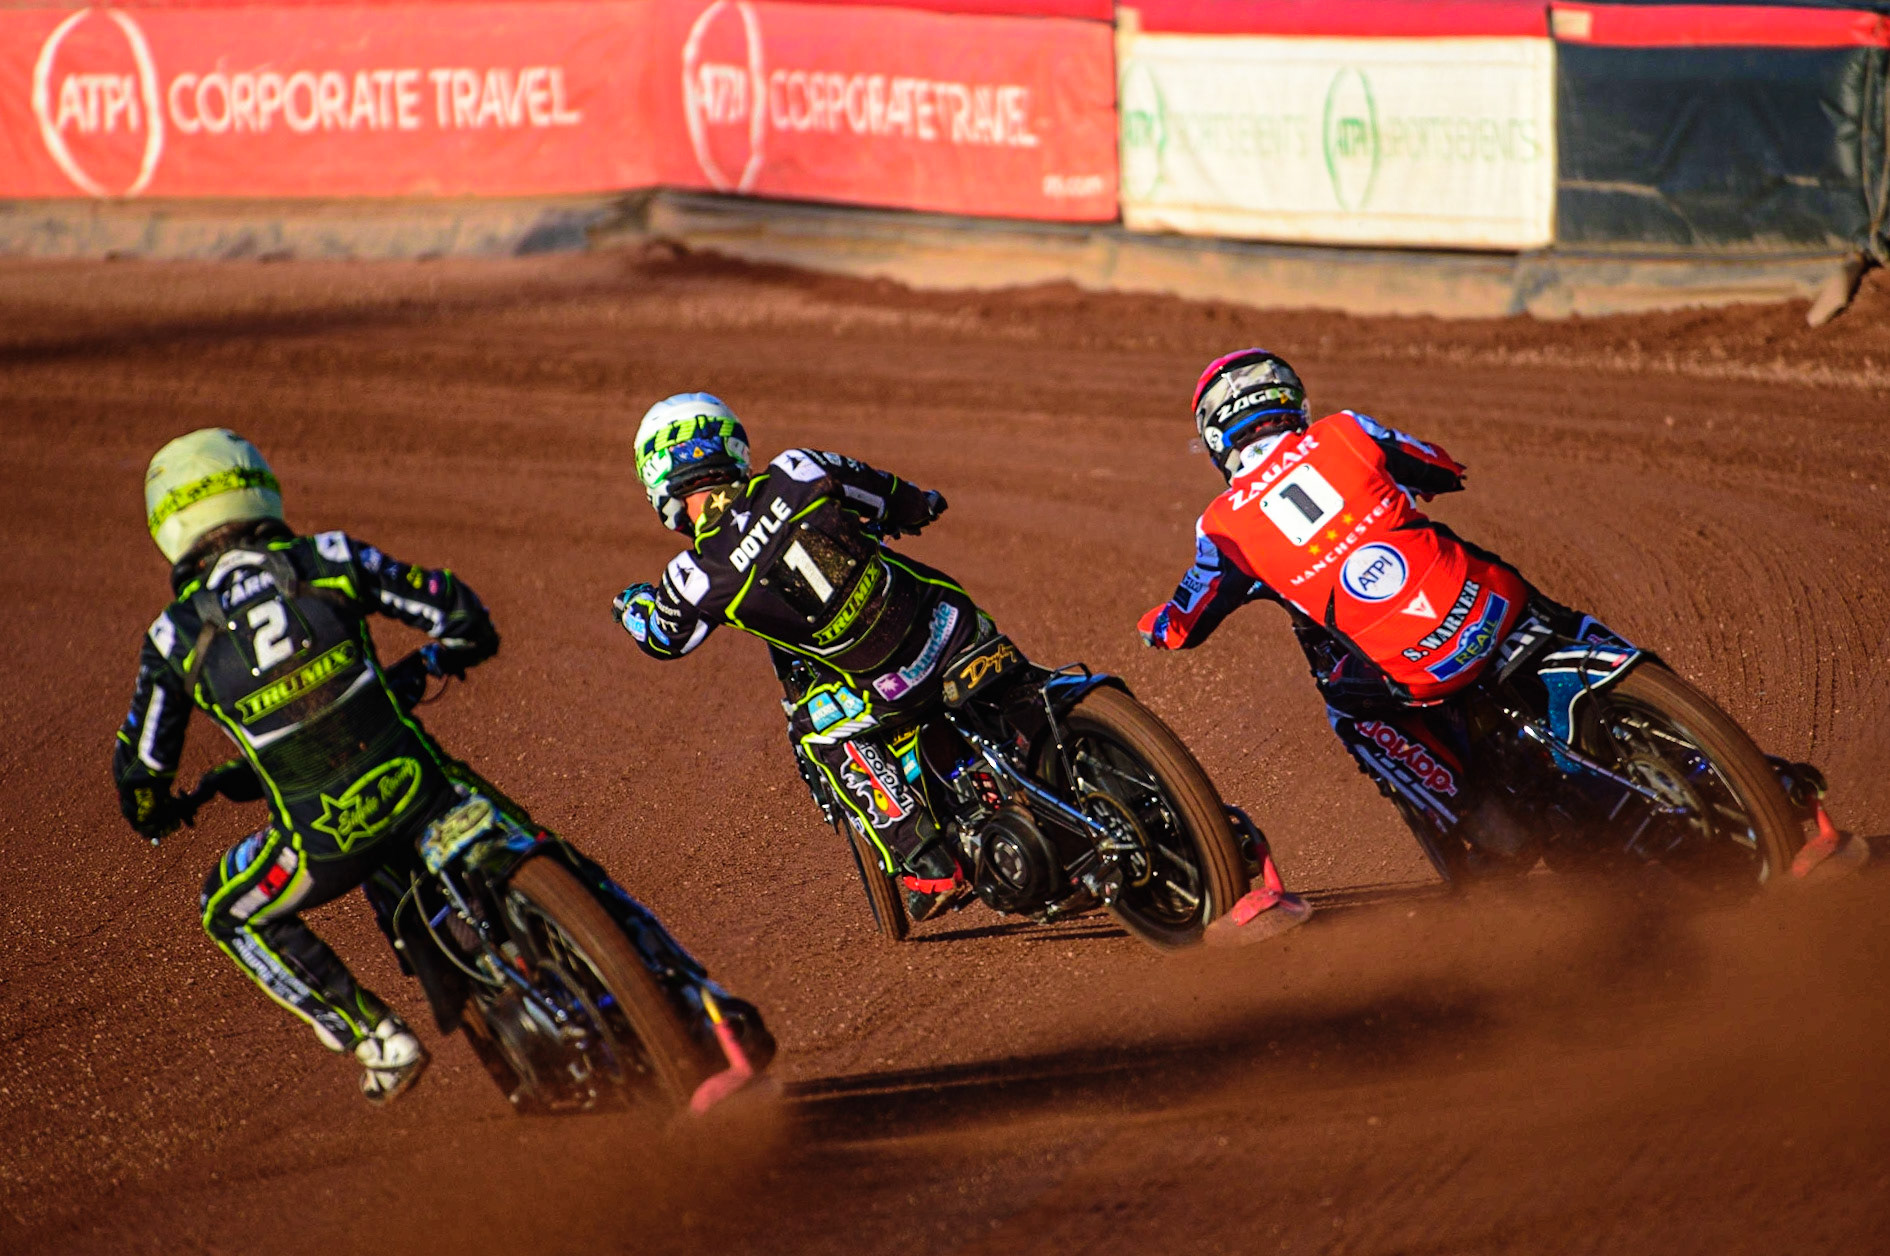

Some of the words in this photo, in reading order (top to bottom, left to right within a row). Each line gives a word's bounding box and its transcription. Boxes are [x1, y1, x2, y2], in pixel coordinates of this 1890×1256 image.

[57, 73, 141, 134] ATPI
[169, 70, 419, 133] CORPORATE
[430, 67, 583, 128] TRAVEL
[769, 70, 936, 141] CORPORATE
[937, 80, 1040, 147] TRAVEL
[729, 496, 792, 573] DOYLE
[1278, 482, 1325, 525] 1
[782, 539, 834, 604] 1
[1289, 497, 1391, 586] MANCHESTER
[1357, 555, 1394, 592] ATPI
[247, 599, 295, 672] 2
[821, 563, 881, 641] TRUMIX
[1418, 579, 1481, 650] WARNER
[901, 602, 951, 680] burnside
